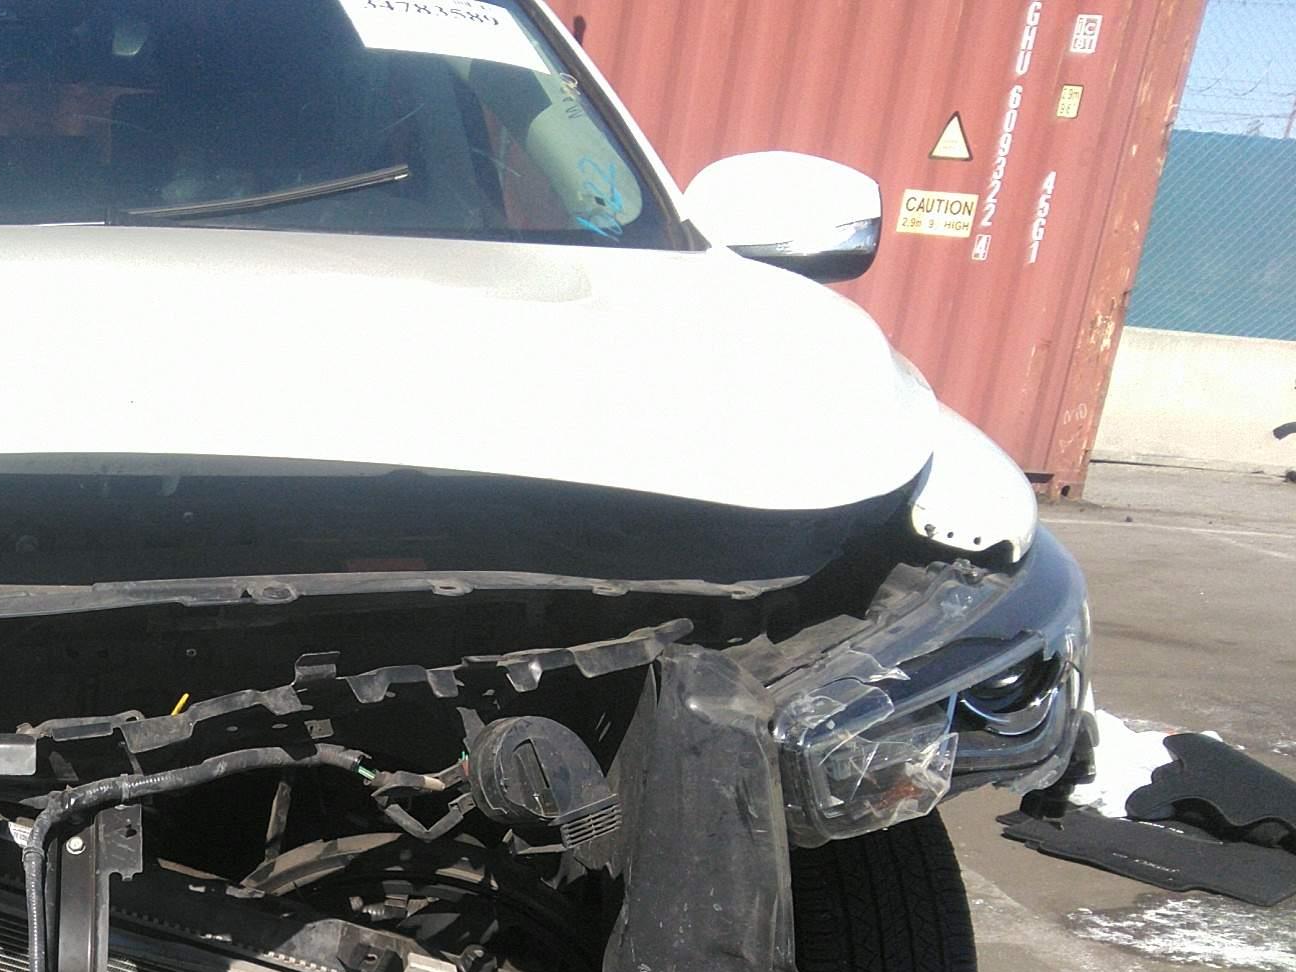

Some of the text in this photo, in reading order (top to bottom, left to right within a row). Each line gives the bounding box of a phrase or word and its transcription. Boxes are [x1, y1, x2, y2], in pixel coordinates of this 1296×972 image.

[980, 84, 1023, 229] 609322
[905, 196, 975, 216] CAUTION
[944, 219, 971, 231] HIGH
